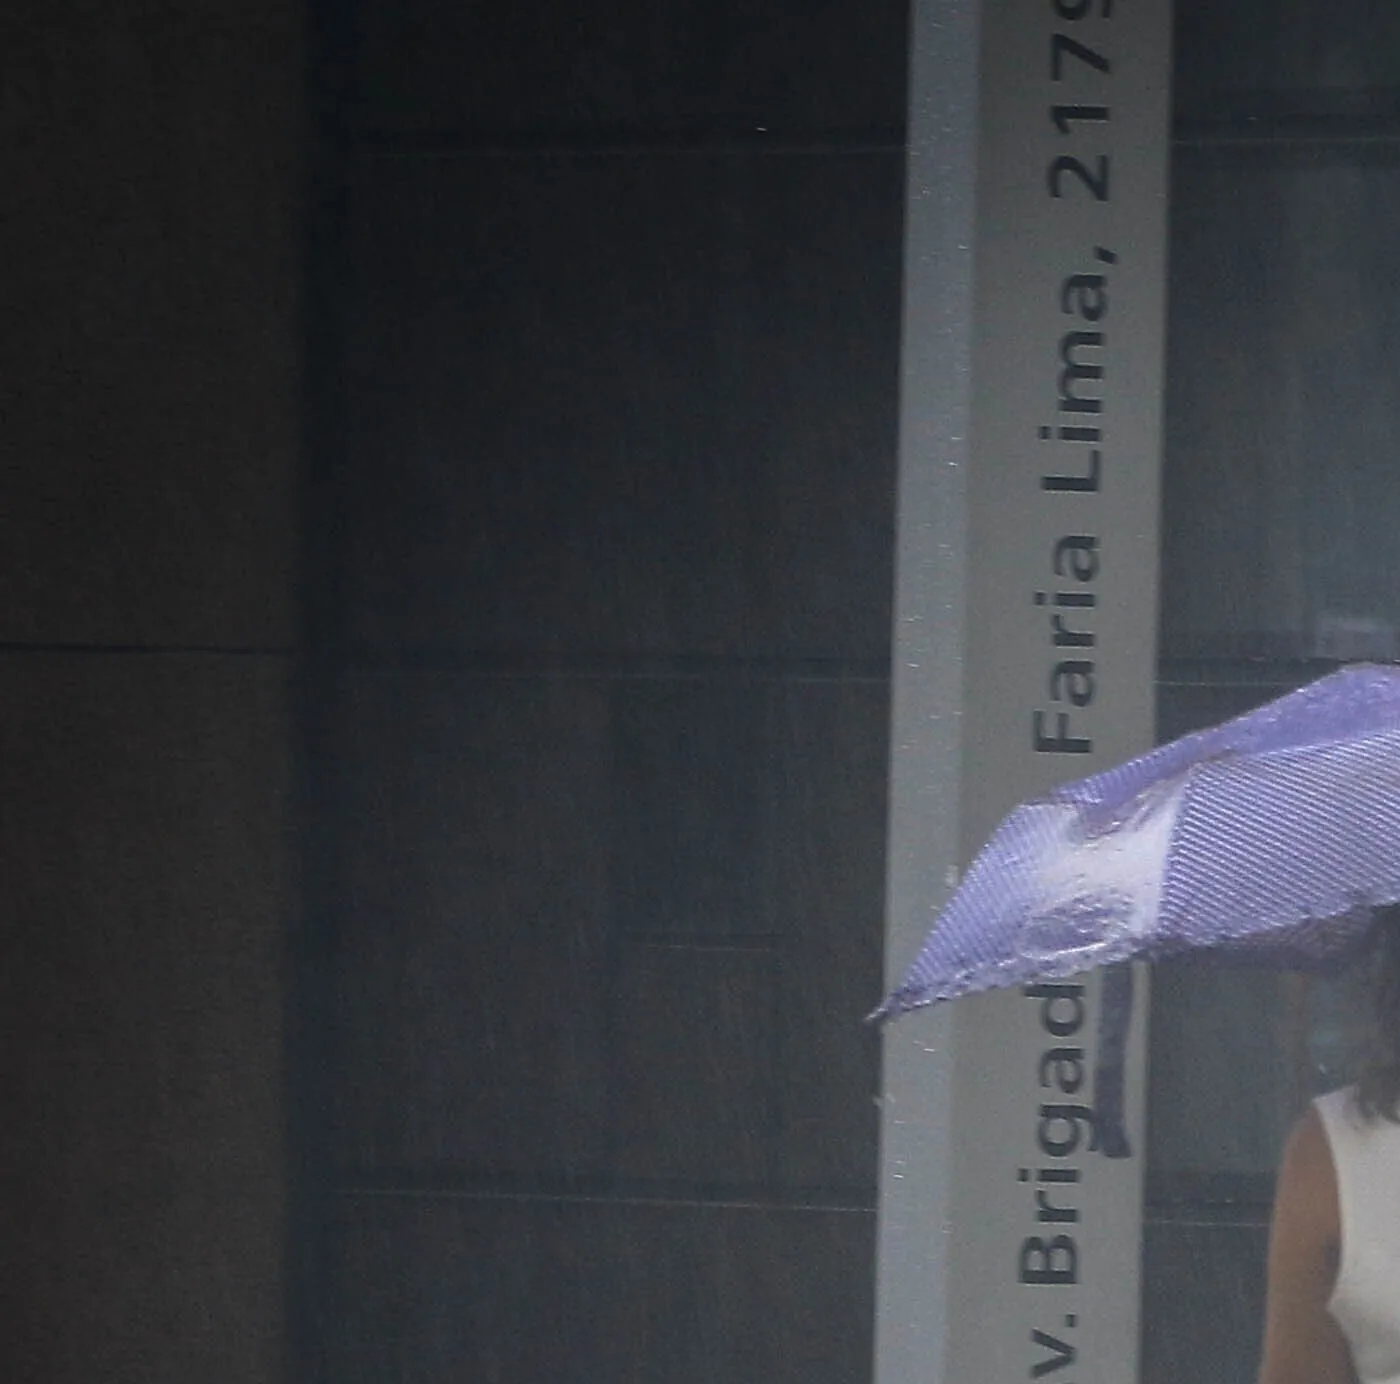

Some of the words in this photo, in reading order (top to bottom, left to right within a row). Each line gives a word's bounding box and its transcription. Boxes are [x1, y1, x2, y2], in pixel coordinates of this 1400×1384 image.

[1038, 246, 1118, 494] Lima,
[1031, 535, 1099, 757] Faria
[1016, 983, 1098, 1286] Brigad
